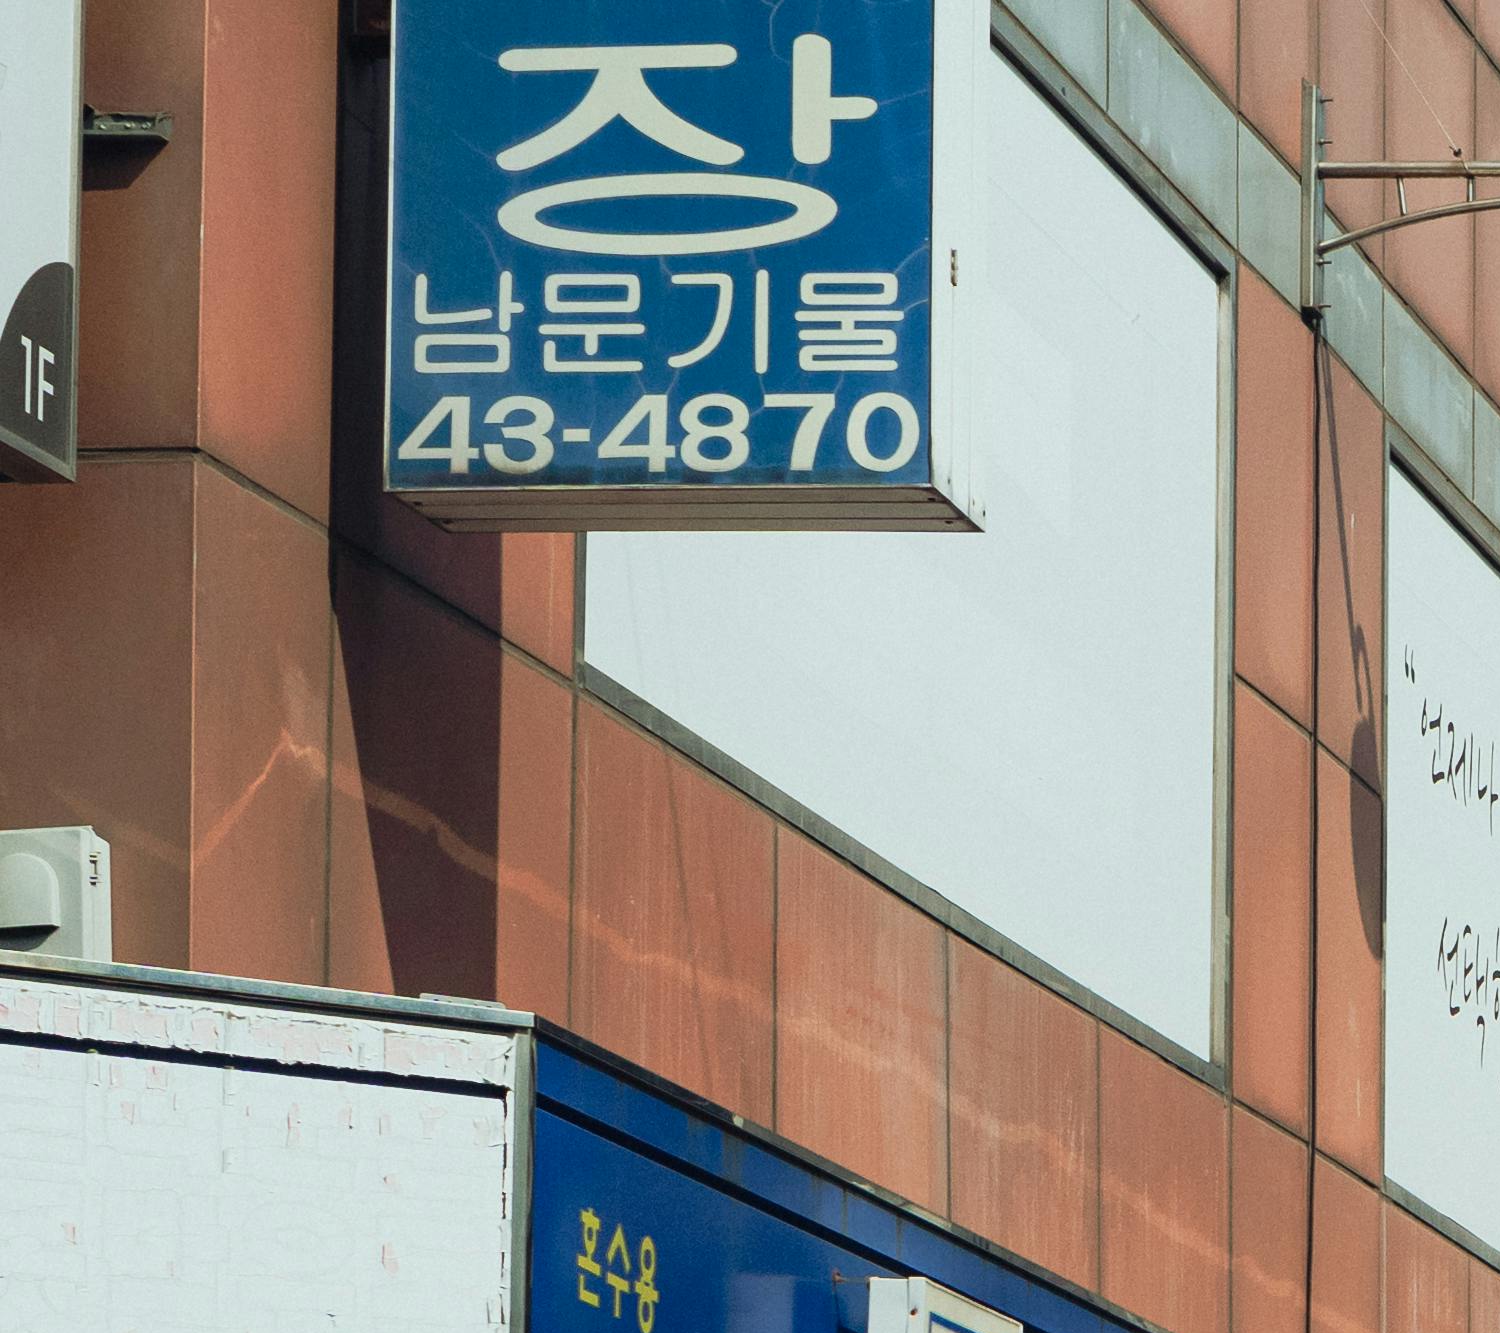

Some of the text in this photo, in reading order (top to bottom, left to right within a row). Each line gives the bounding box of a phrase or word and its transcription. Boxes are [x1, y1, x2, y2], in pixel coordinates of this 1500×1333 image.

[497, 33, 878, 256] 장
[413, 269, 905, 374] 남문기물
[20, 334, 57, 422] 1F
[398, 393, 920, 475] 43-4870
